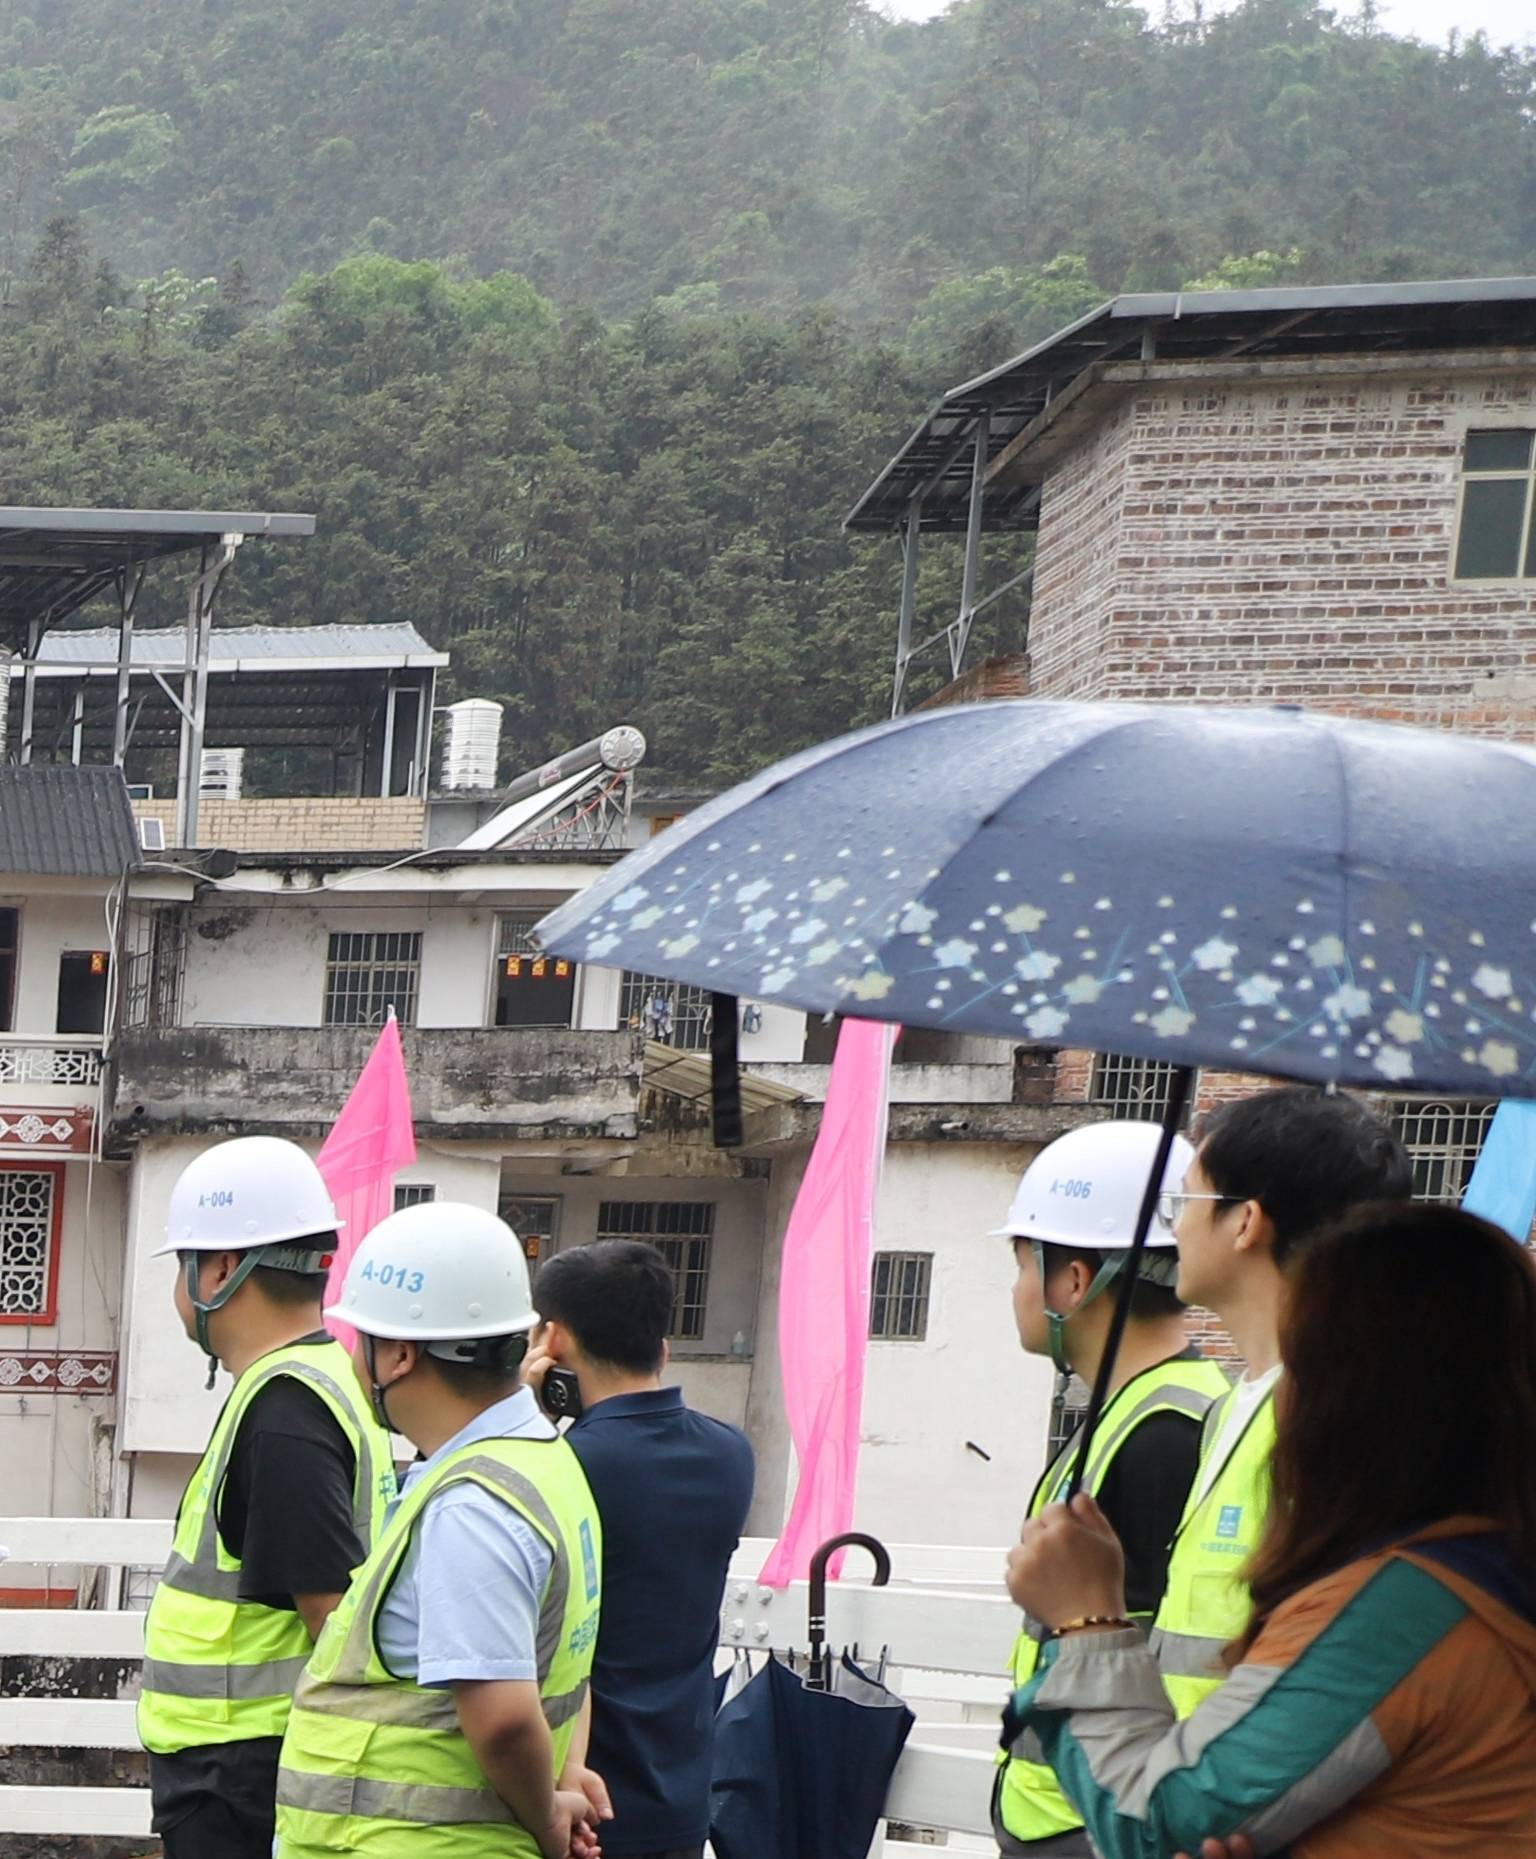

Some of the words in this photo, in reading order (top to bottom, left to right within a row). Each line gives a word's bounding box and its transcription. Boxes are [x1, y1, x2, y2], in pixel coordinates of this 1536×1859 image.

[1049, 1179, 1092, 1199] A-006
[198, 1191, 233, 1208] A-004
[361, 1260, 425, 1293] A-013
